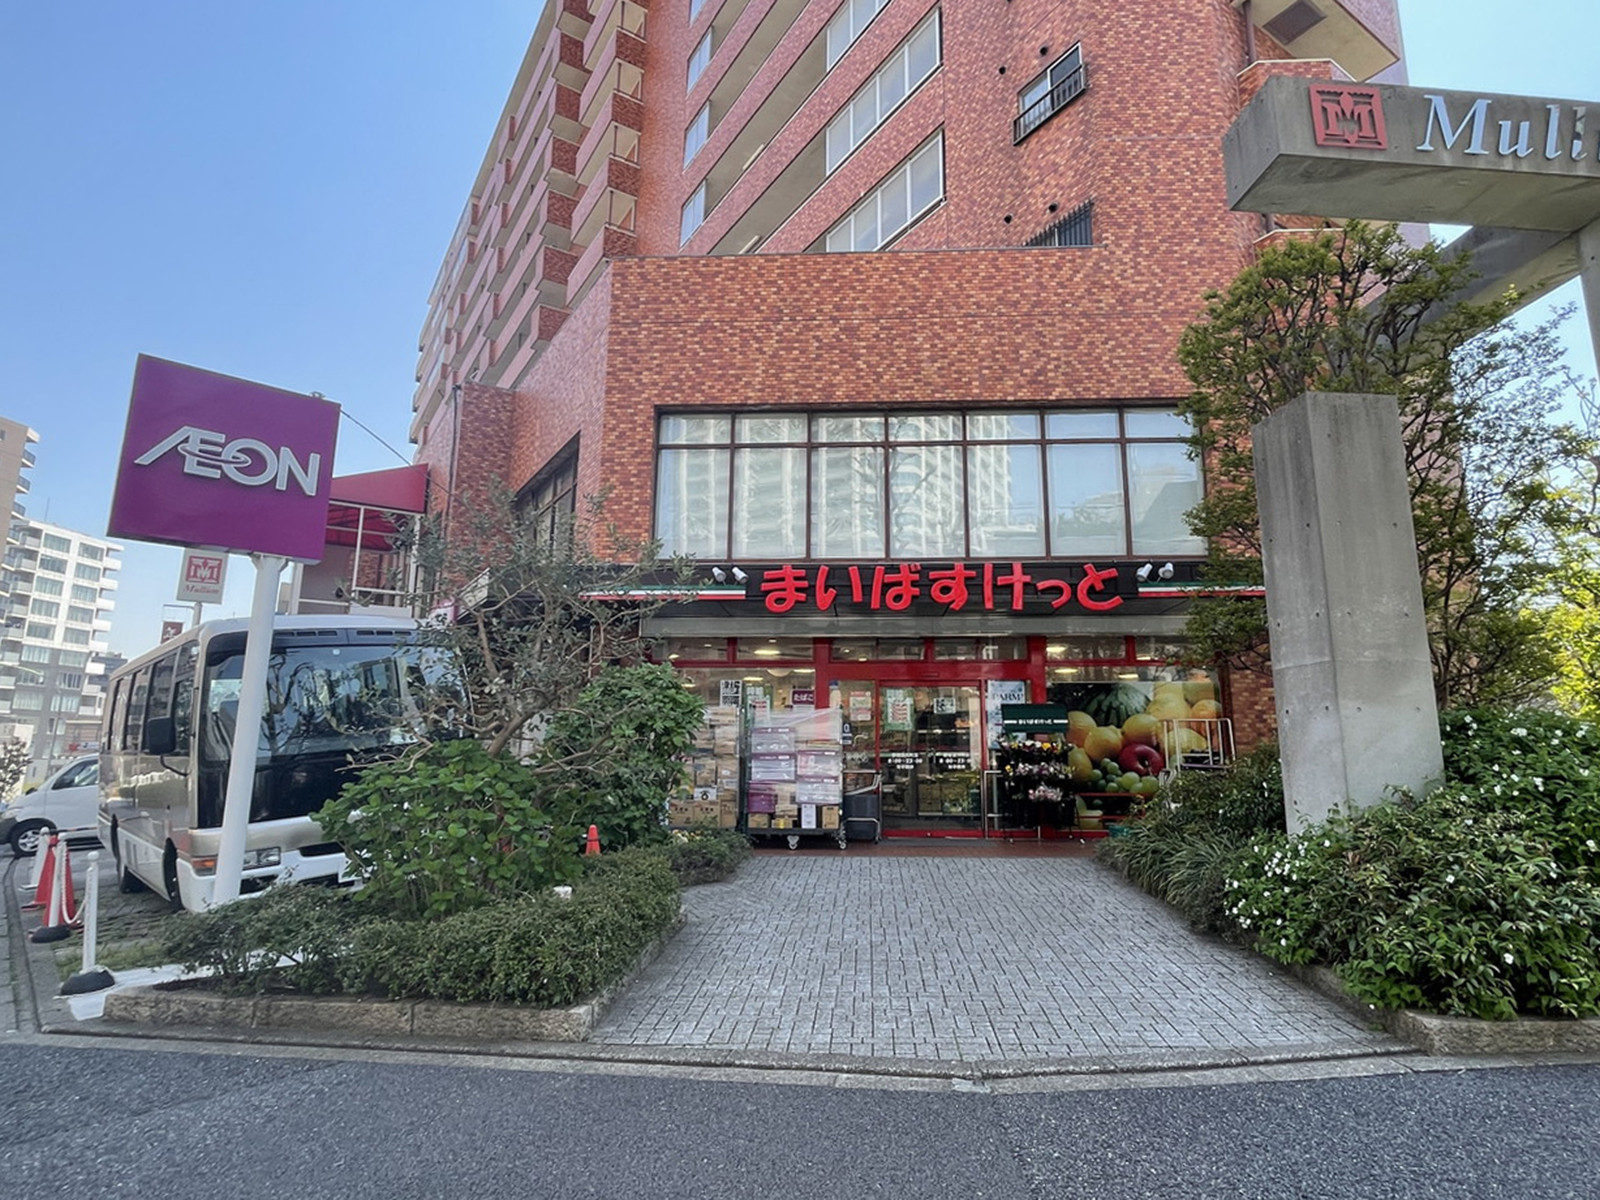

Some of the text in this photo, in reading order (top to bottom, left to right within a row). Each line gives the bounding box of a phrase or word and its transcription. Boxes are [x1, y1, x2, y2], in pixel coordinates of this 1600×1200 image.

[760, 562, 1124, 614] まいばすけっと
